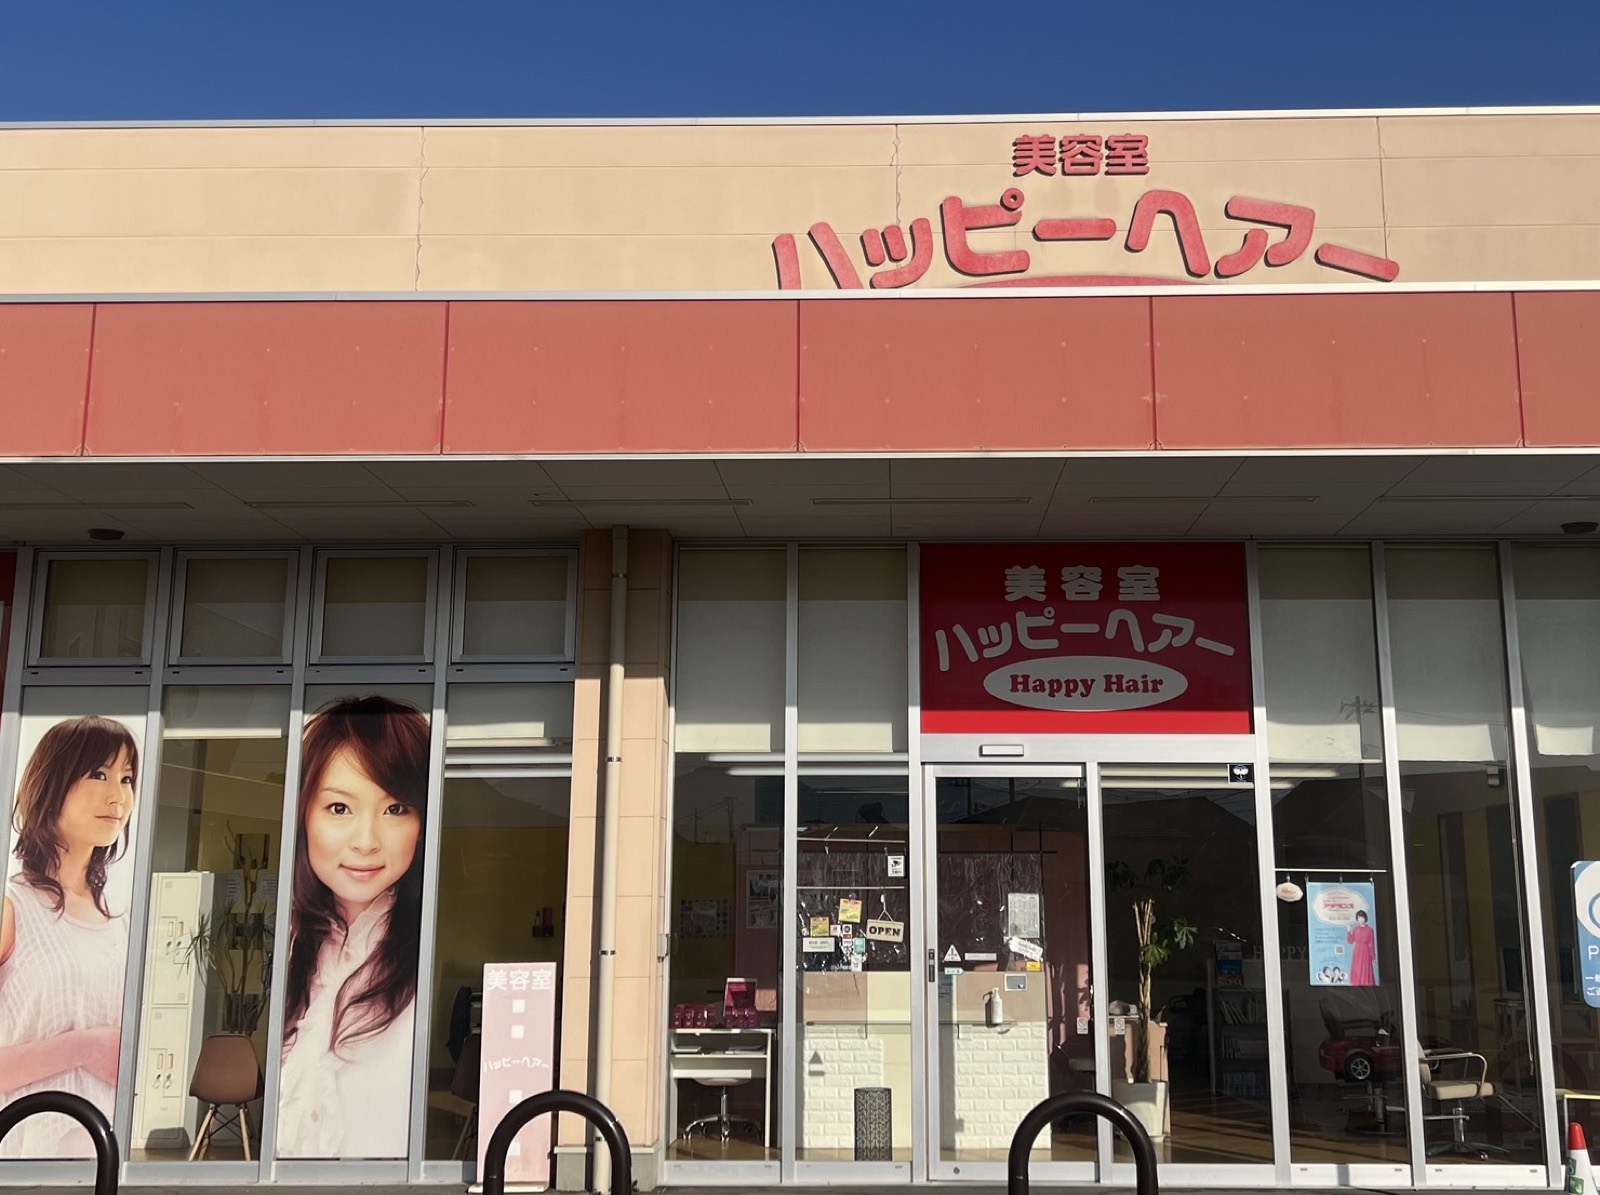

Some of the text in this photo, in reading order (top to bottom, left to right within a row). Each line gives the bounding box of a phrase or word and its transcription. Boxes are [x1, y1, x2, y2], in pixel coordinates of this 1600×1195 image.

[1012, 133, 1150, 177] 美容室
[771, 187, 1400, 289] ハッピーヘアー
[1004, 565, 1161, 601] 美容室
[935, 606, 1235, 672] ハッピーヘアー
[1009, 674, 1164, 698] Happy Hair
[868, 925, 902, 938] OPEN
[487, 968, 552, 991] 美容室
